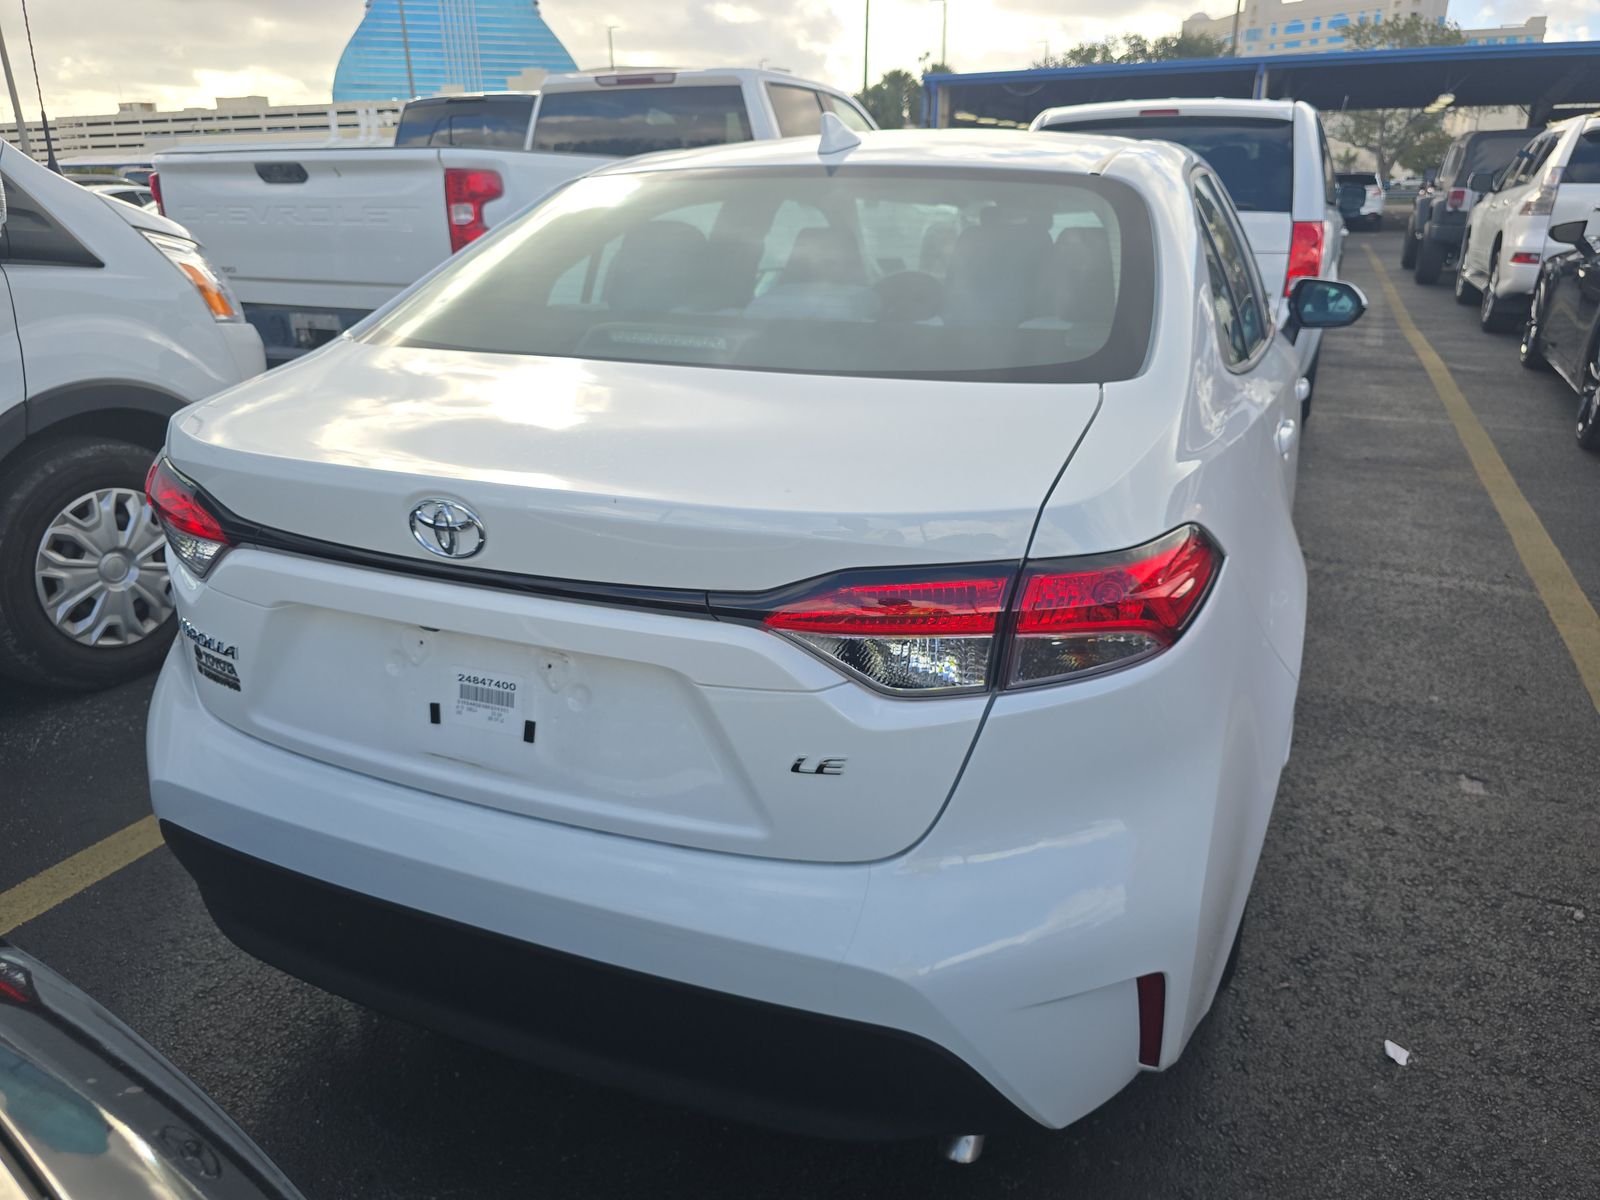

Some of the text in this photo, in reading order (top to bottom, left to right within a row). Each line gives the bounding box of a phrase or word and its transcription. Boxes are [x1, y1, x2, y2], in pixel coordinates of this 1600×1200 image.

[178, 203, 421, 229] CHEVROLET
[202, 651, 238, 677] TOYOTA
[457, 673, 517, 691] 24847400
[790, 755, 847, 776] LE
